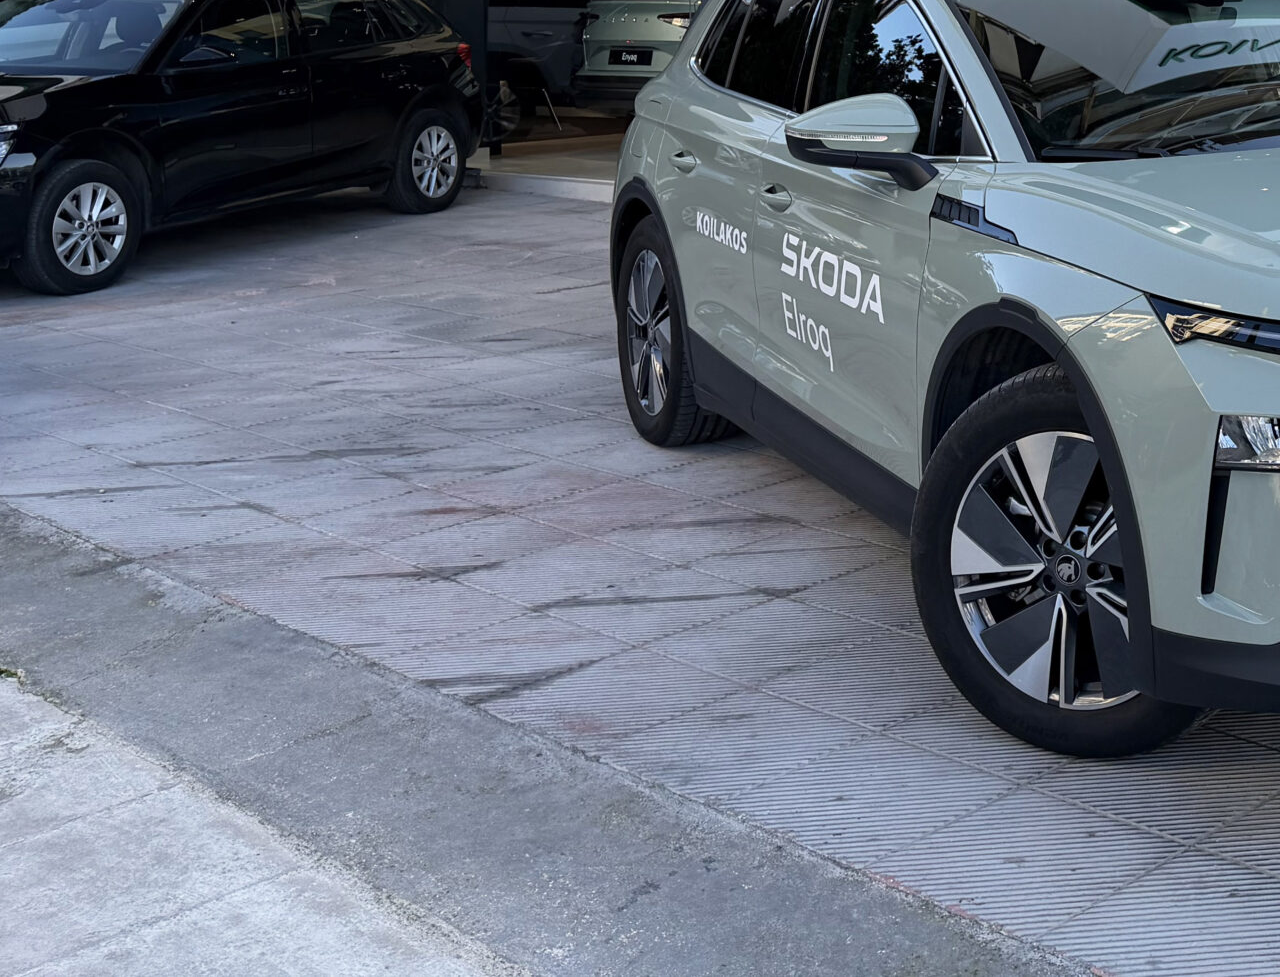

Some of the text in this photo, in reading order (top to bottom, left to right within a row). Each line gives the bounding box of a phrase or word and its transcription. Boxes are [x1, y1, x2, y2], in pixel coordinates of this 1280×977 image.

[696, 211, 748, 255] KOILAKOS
[780, 232, 885, 324] SKODA
[782, 291, 834, 372] Elroq
